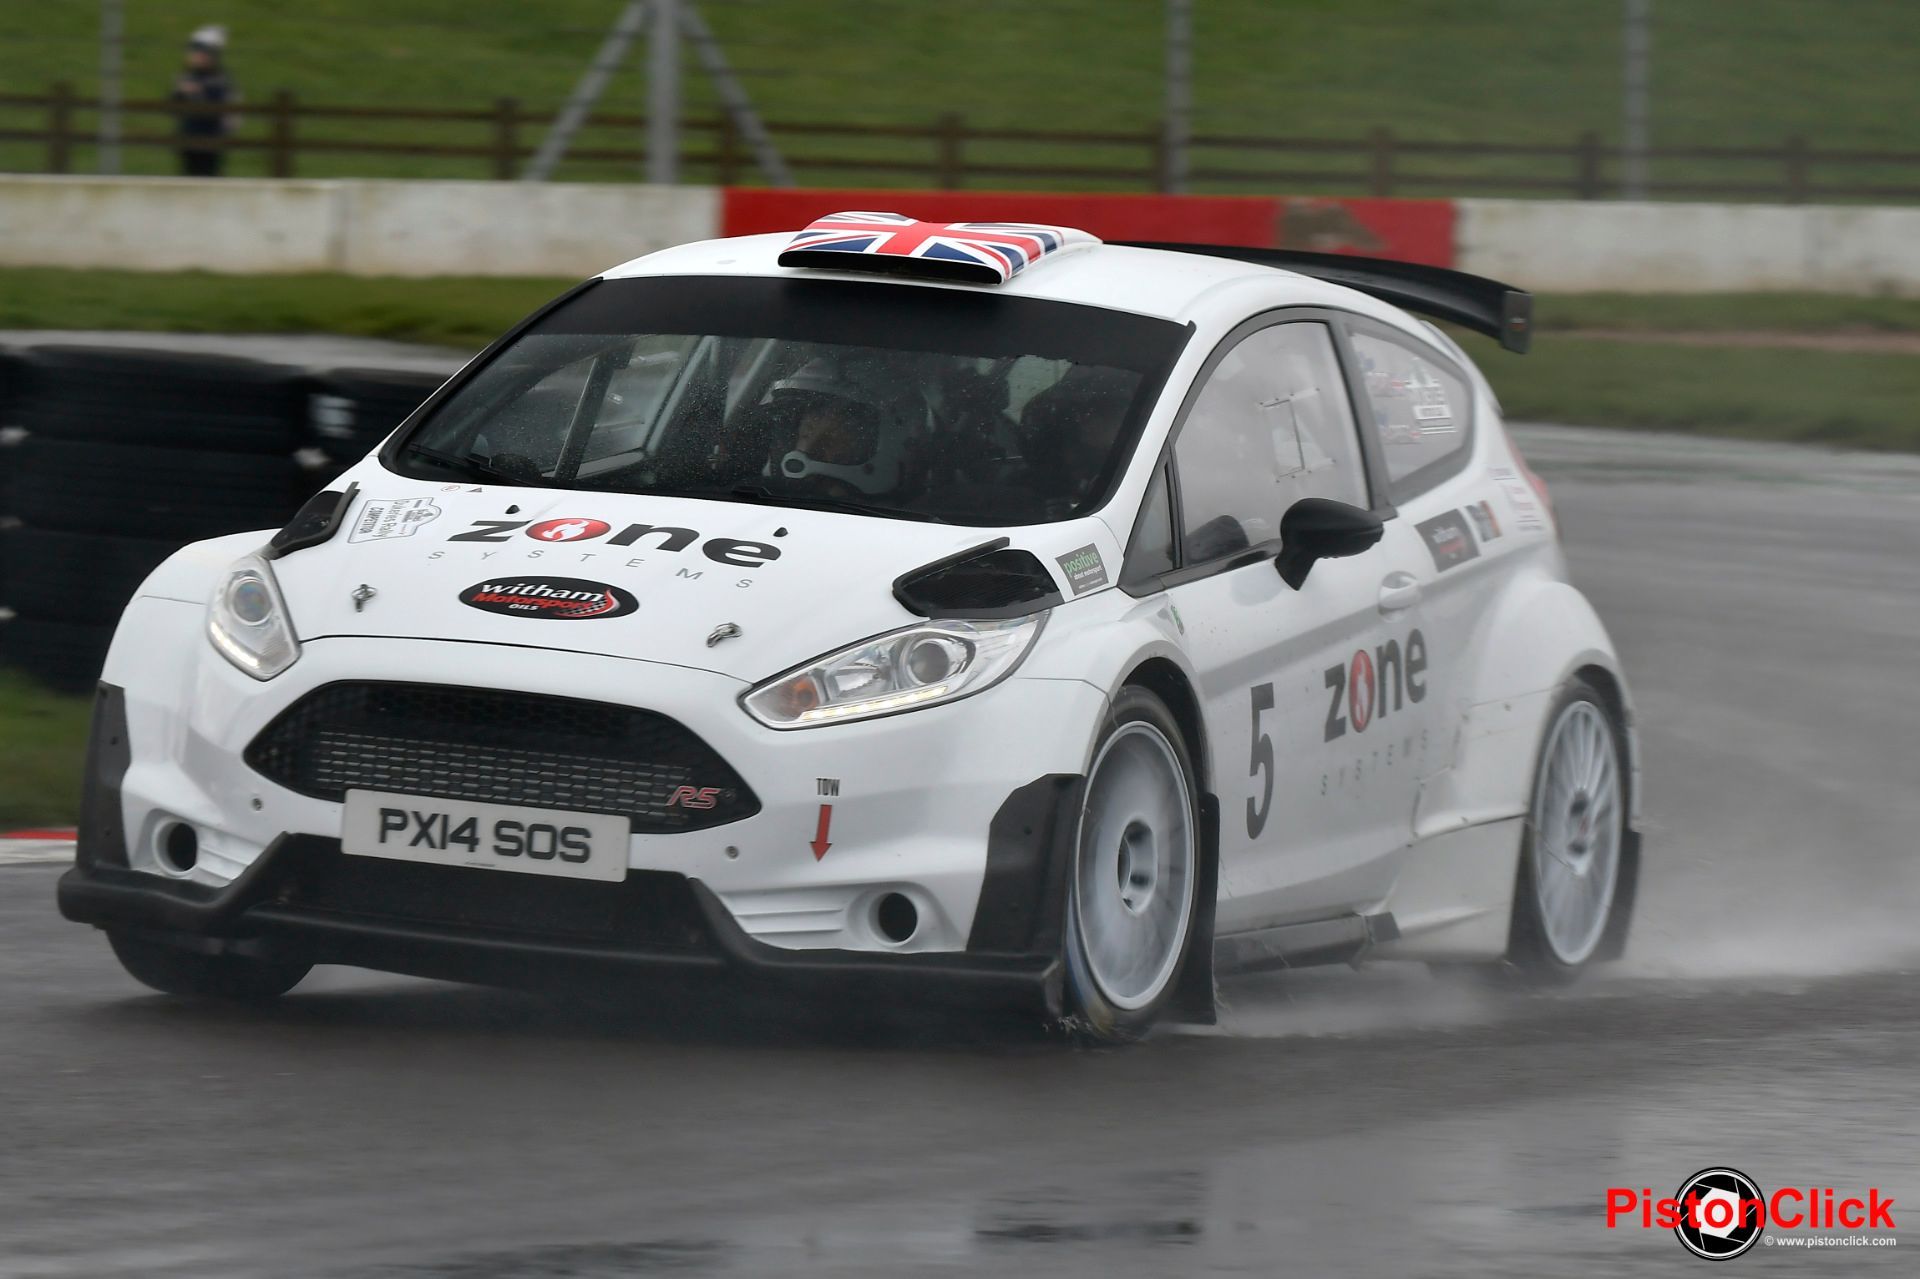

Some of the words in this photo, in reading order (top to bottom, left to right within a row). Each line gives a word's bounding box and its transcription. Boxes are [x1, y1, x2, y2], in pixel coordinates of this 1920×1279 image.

[359, 506, 384, 534] COMPETITOR
[446, 517, 782, 568] zone
[428, 549, 753, 588] SYSTEMS
[1064, 552, 1099, 578] positive
[472, 593, 595, 610] Motorsport
[481, 583, 606, 603] witham
[508, 603, 540, 611] OILS
[1323, 628, 1429, 743] zone
[1246, 682, 1275, 840] 5
[1319, 730, 1429, 797] SYSTEMS
[664, 785, 721, 809] RS
[815, 777, 841, 797] TOW
[379, 807, 480, 853] PX14
[492, 819, 592, 864] SOS
